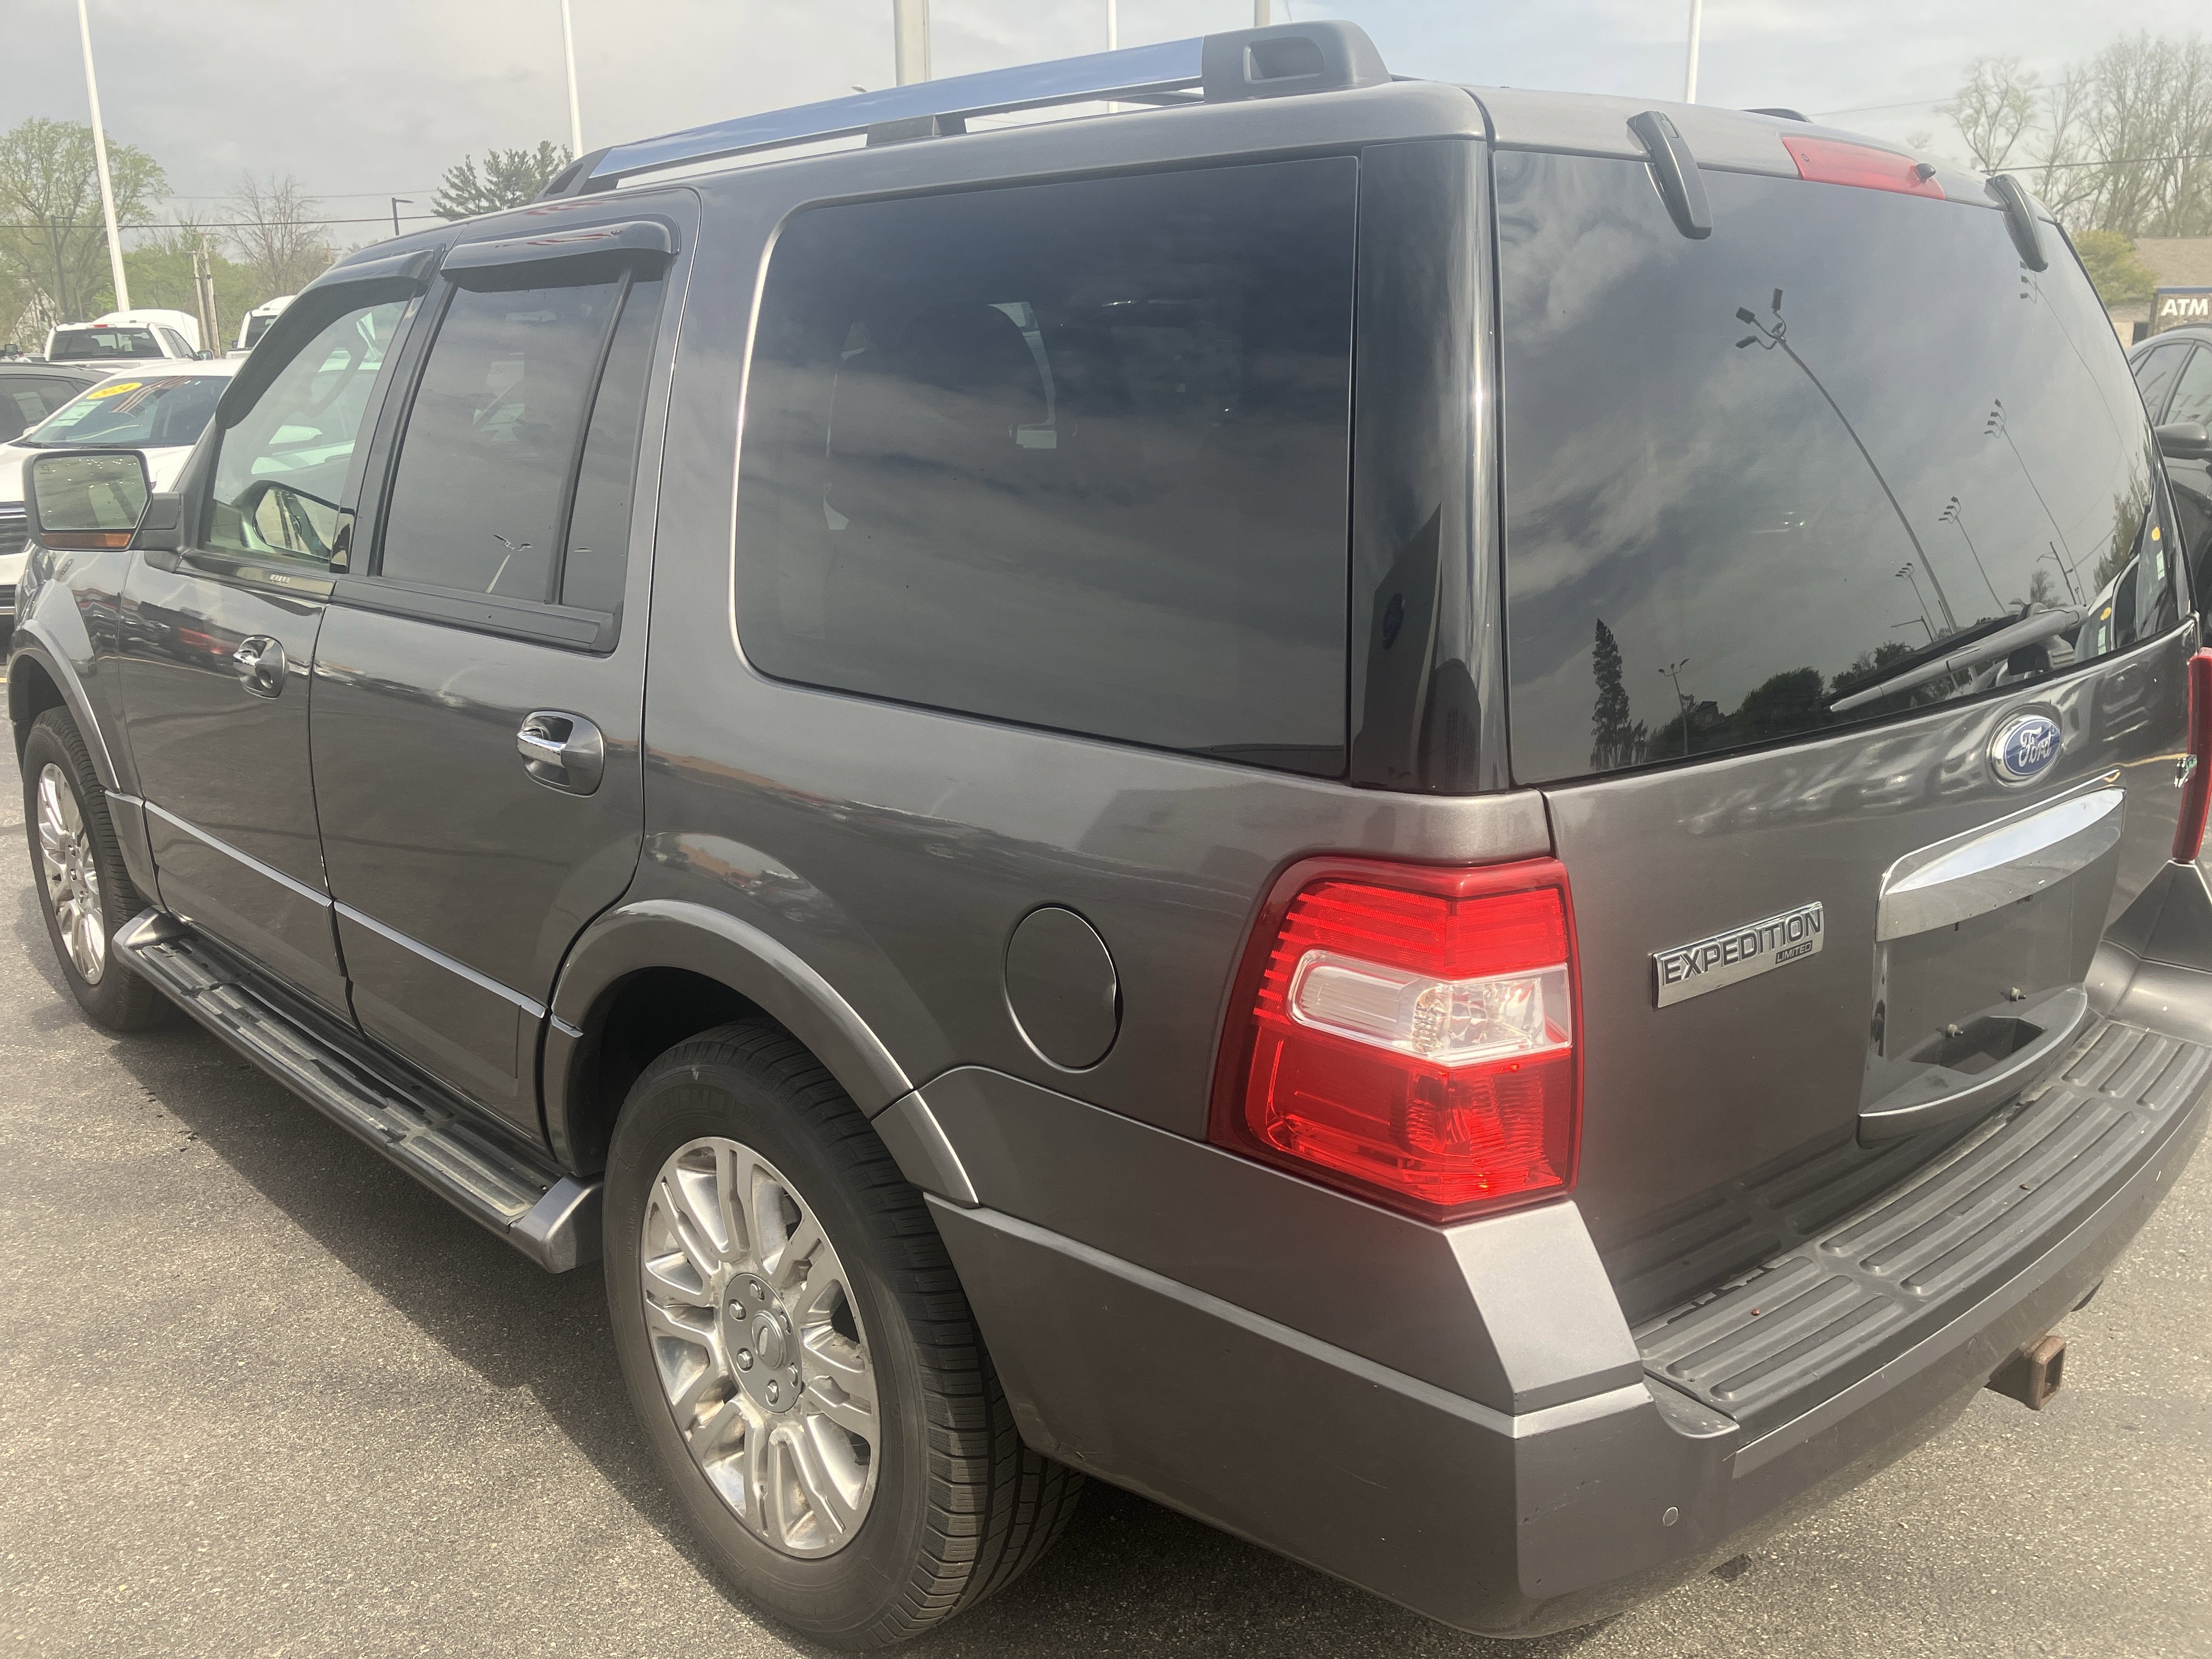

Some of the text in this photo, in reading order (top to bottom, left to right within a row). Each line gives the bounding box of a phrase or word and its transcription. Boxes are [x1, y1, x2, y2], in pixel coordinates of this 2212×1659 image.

[2160, 298, 2209, 317] ATM
[2018, 726, 2052, 768] Ford
[1663, 908, 1822, 985] EXPEDITION
[1776, 941, 1812, 962] LIMITED
